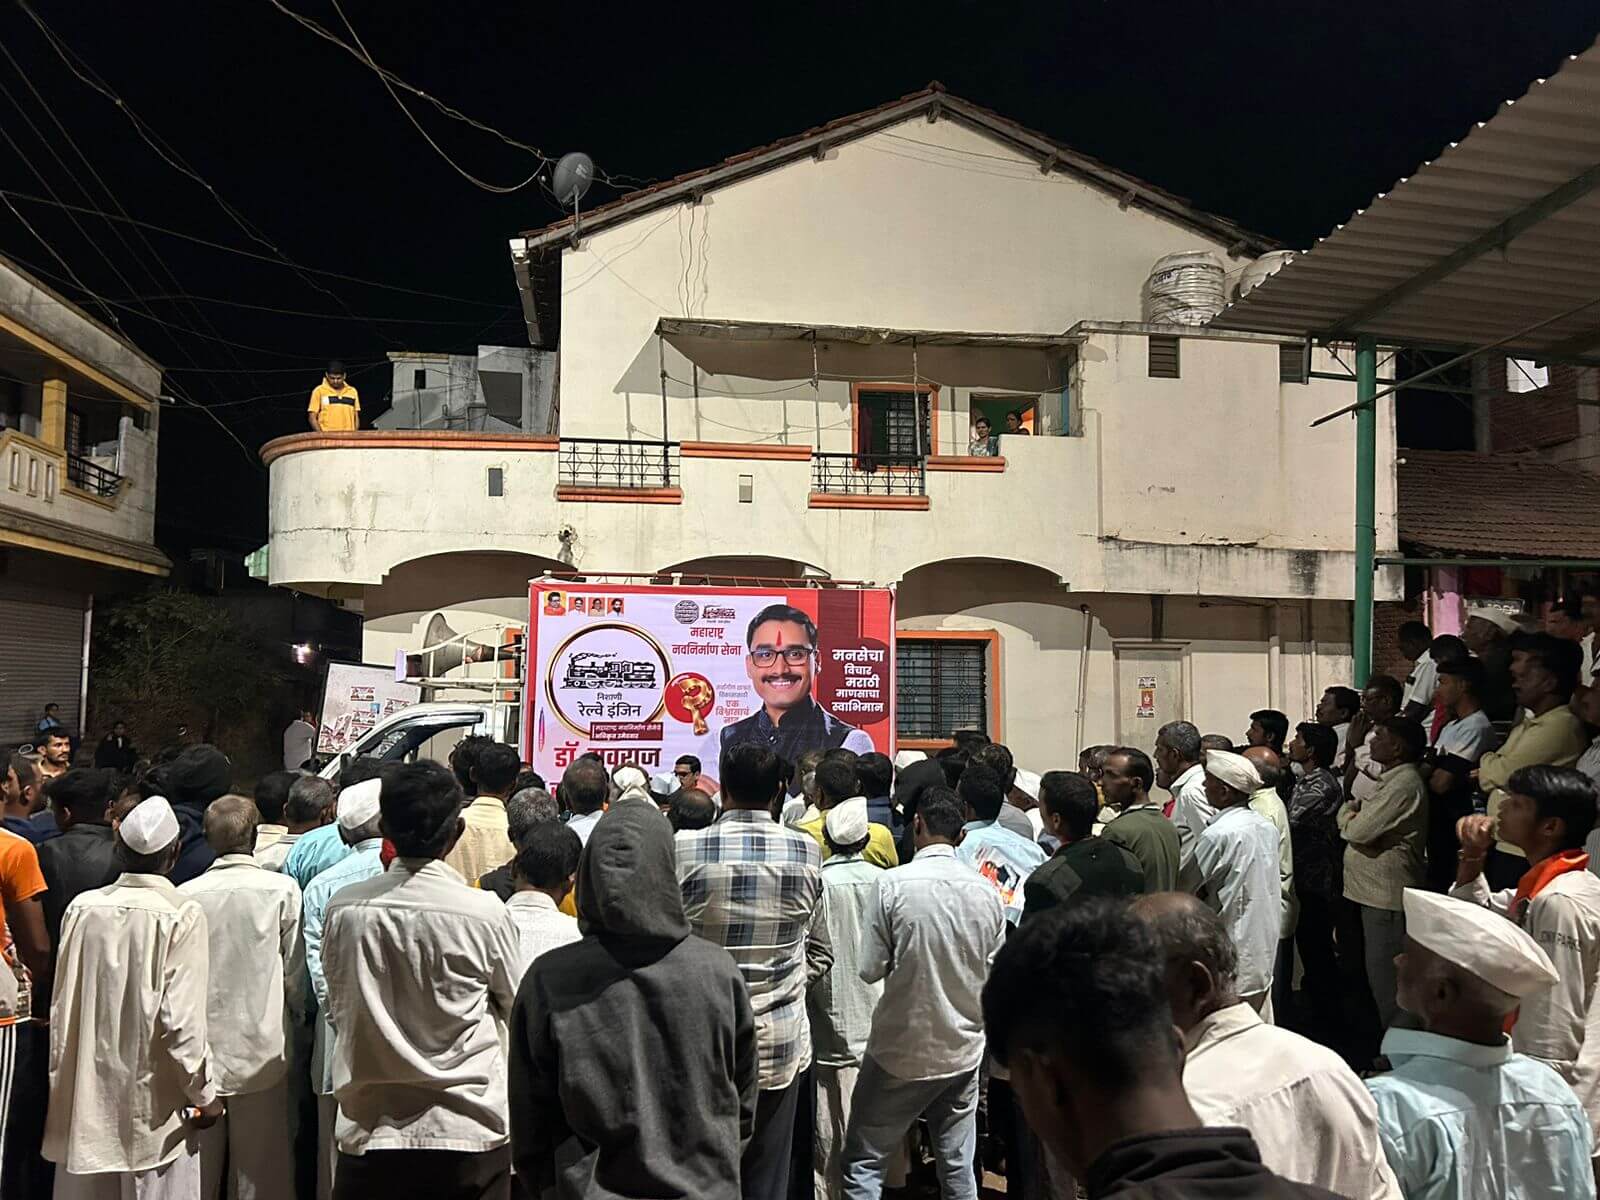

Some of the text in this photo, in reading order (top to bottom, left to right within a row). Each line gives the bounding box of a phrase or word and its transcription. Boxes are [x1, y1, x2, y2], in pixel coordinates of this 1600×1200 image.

[690, 627, 725, 639] महाराष्ट्र
[672, 642, 742, 656] नवनिर्माण सेना
[832, 646, 885, 662] मनसेचा
[844, 663, 872, 675] विचार
[845, 674, 880, 688] मराठी
[597, 693, 622, 701] निशाणी
[577, 701, 642, 718] रेल्वे इंजिन
[832, 699, 884, 712] स्वाभिमान
